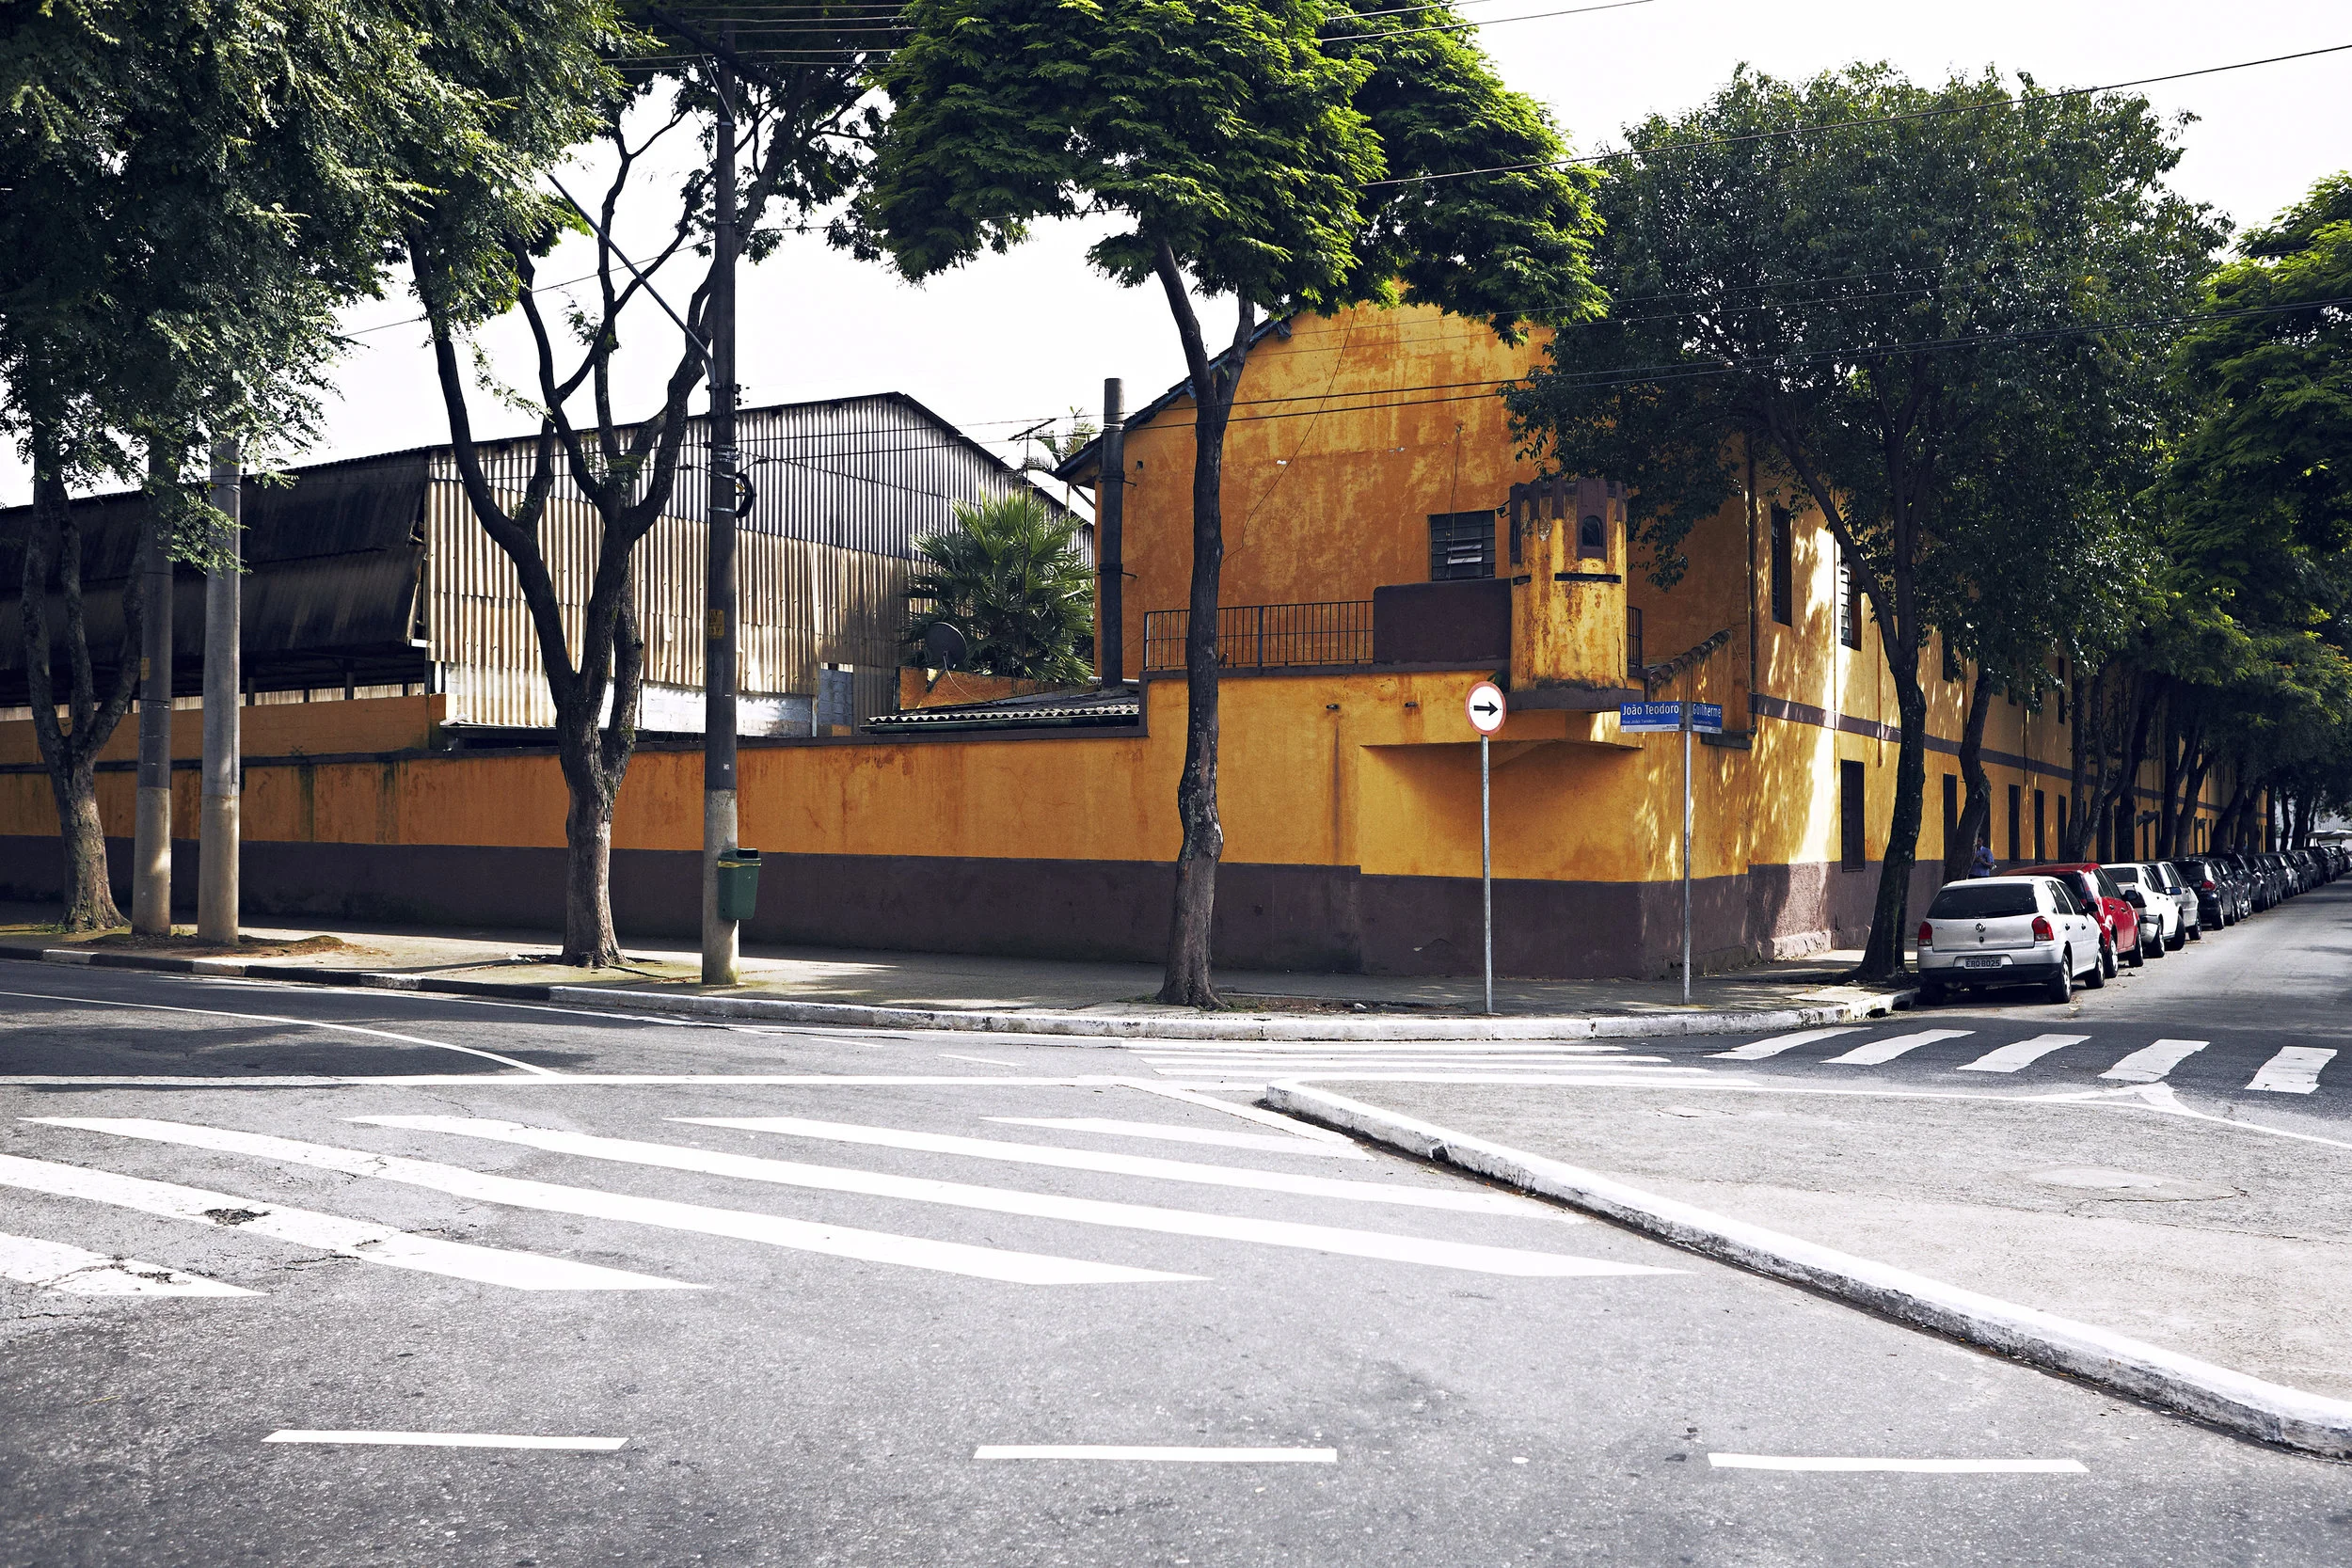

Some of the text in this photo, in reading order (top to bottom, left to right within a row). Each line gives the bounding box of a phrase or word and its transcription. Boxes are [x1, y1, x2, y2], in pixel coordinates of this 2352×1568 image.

[1623, 704, 1679, 716] João Teodoro
[1692, 704, 1722, 718] Guilherme
